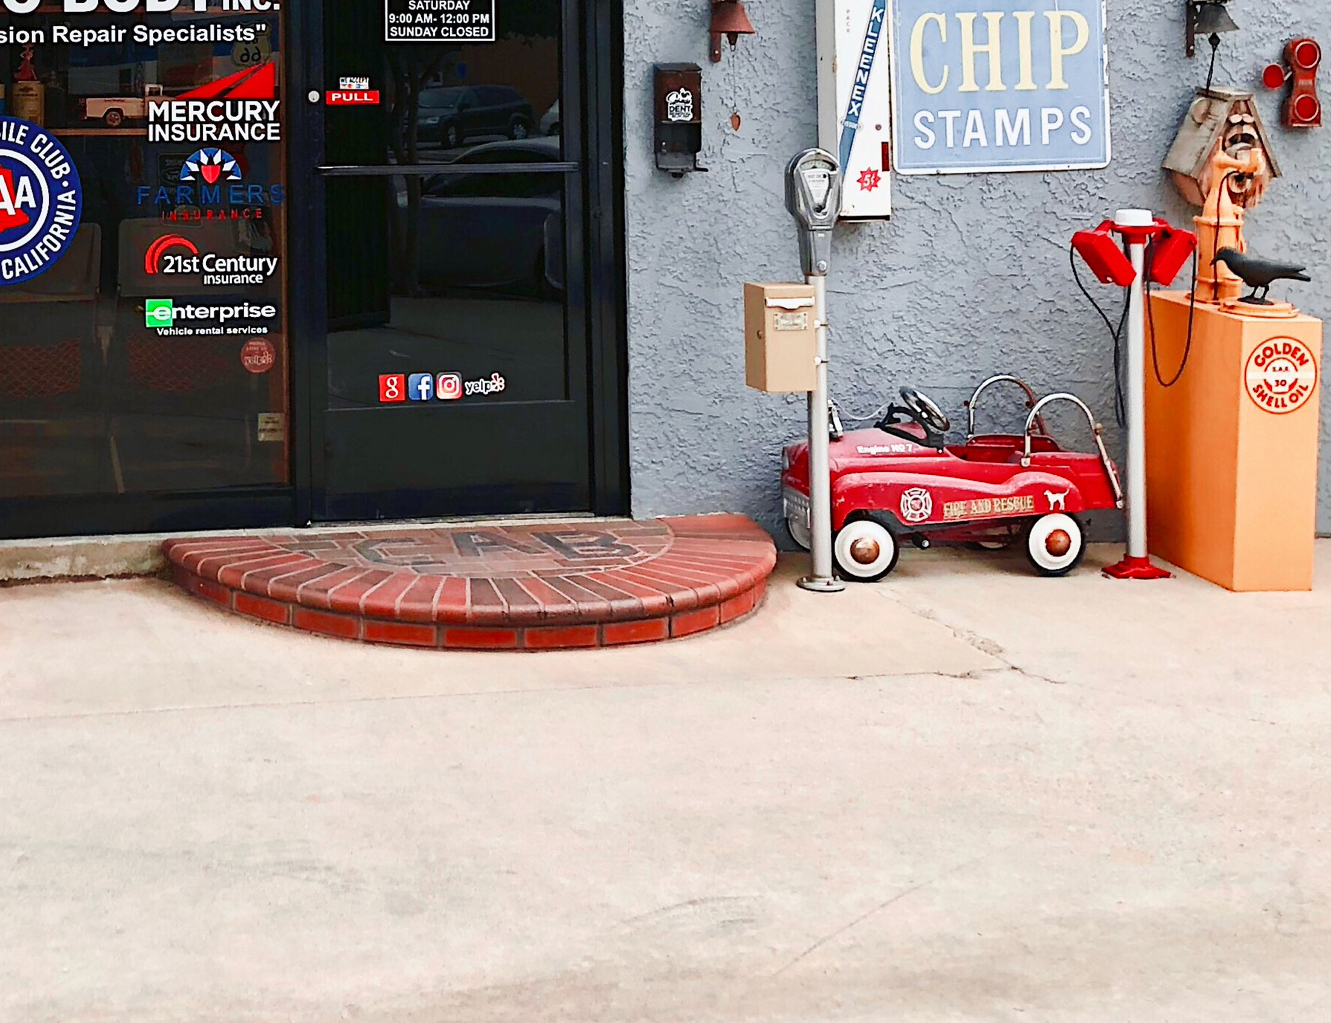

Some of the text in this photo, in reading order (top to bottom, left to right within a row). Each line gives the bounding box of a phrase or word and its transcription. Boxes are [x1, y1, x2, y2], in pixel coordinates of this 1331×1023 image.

[408, 0, 471, 11] SATURDAY
[389, 14, 413, 24] 9:00
[440, 14, 469, 24] 12:00
[472, 14, 490, 23] PM
[53, 25, 127, 47] Repair
[133, 23, 267, 46] Specialists"
[389, 27, 489, 37] SUNDAY CLOSED
[848, 7, 884, 116] KLEENEX
[909, 10, 1090, 94] CHIP
[331, 92, 374, 102] PULL
[148, 100, 280, 122] MERCURY
[148, 123, 281, 142] INSURANCE
[913, 106, 1092, 149] STAMPS
[30, 133, 71, 179] CLUB
[137, 184, 286, 205] FARMERS
[161, 207, 262, 221] INSURANCE
[1, 189, 76, 280] CALIFORNIA
[163, 254, 278, 276] 21st Century
[204, 274, 264, 285] insurance
[153, 302, 276, 322] enterprise
[156, 326, 268, 336] Vehicle rental services
[1254, 342, 1310, 367] GOLDEN
[465, 379, 492, 395] yelp
[1275, 379, 1287, 387] 30
[1253, 384, 1309, 408] SHELL OIL
[943, 496, 1035, 519] FIRE AND RESCUE
